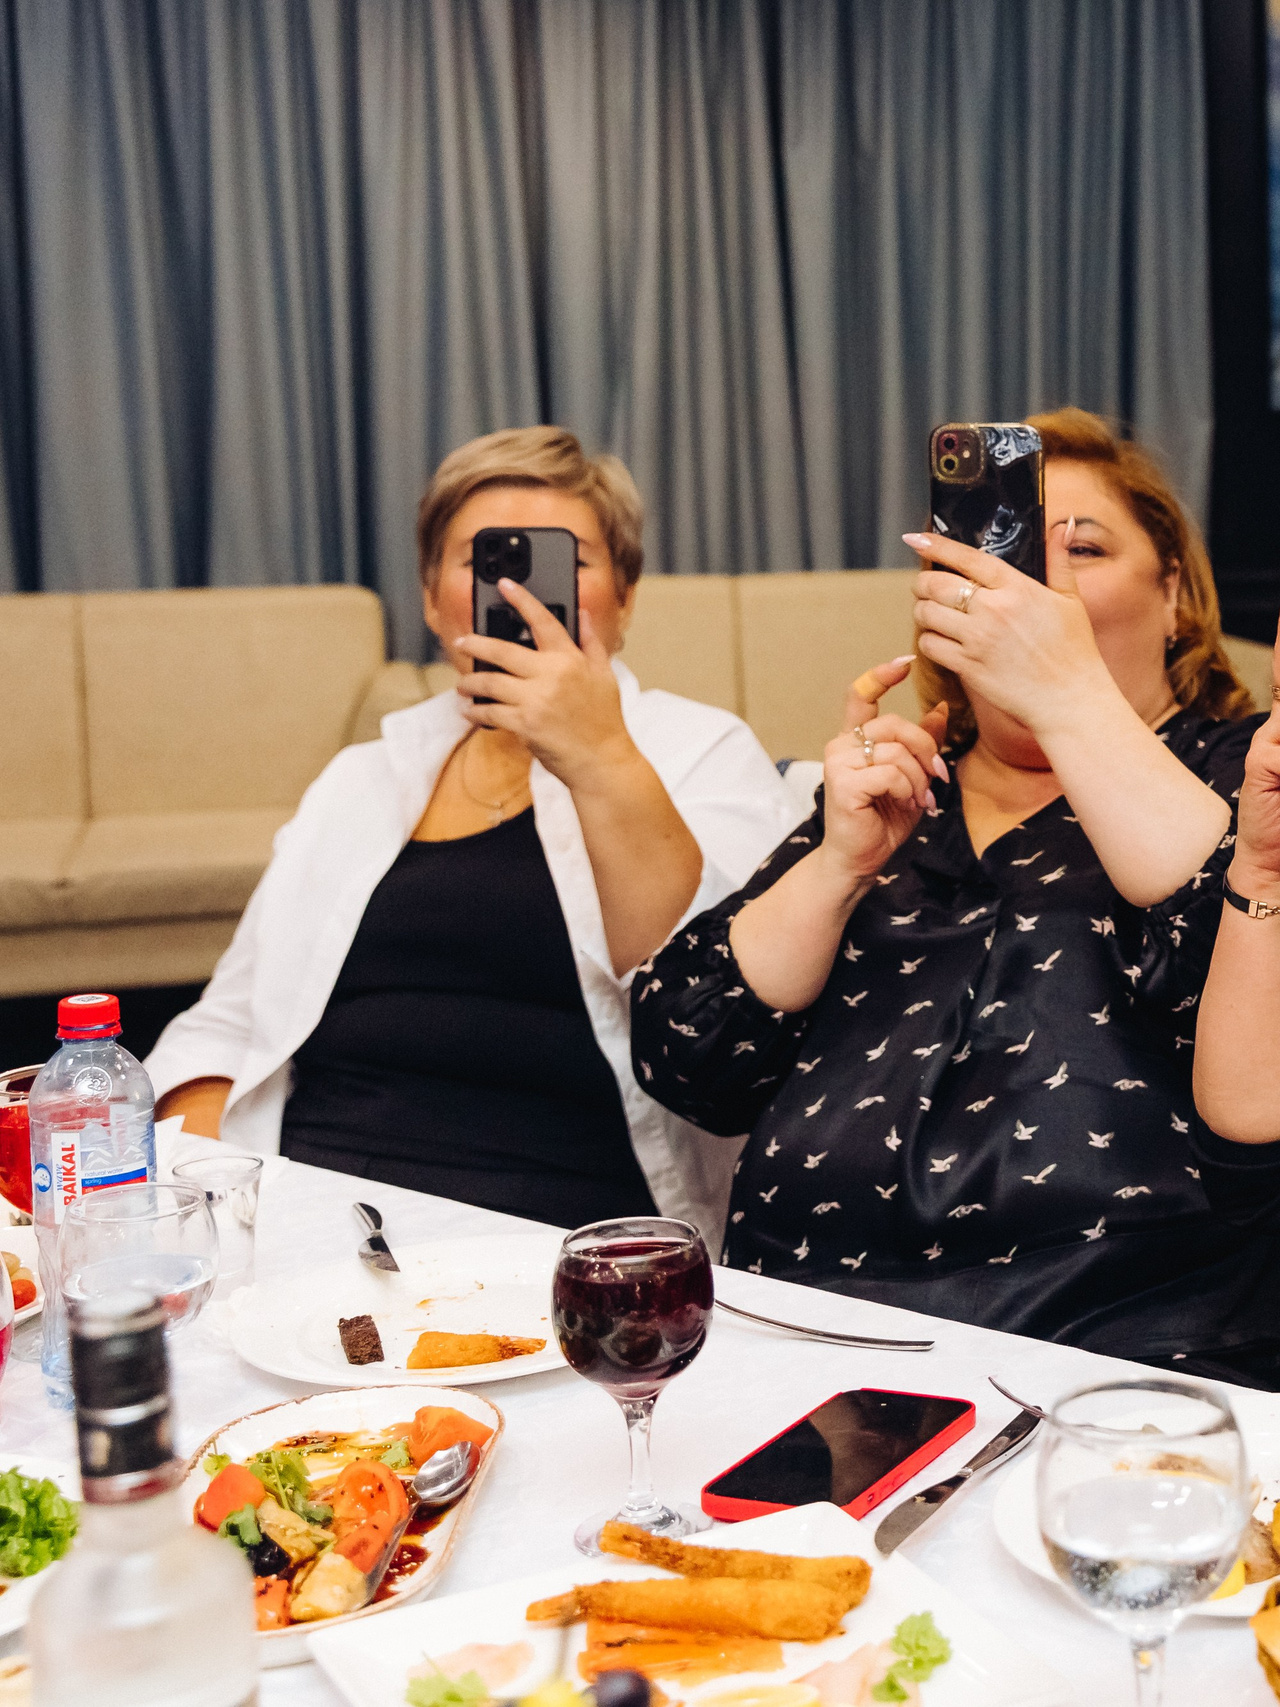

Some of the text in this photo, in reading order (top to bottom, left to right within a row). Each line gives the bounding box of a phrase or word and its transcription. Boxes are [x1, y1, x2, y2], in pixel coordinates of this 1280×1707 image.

[61, 1143, 77, 1206] BAIKAL
[84, 1167, 124, 1178] natural water
